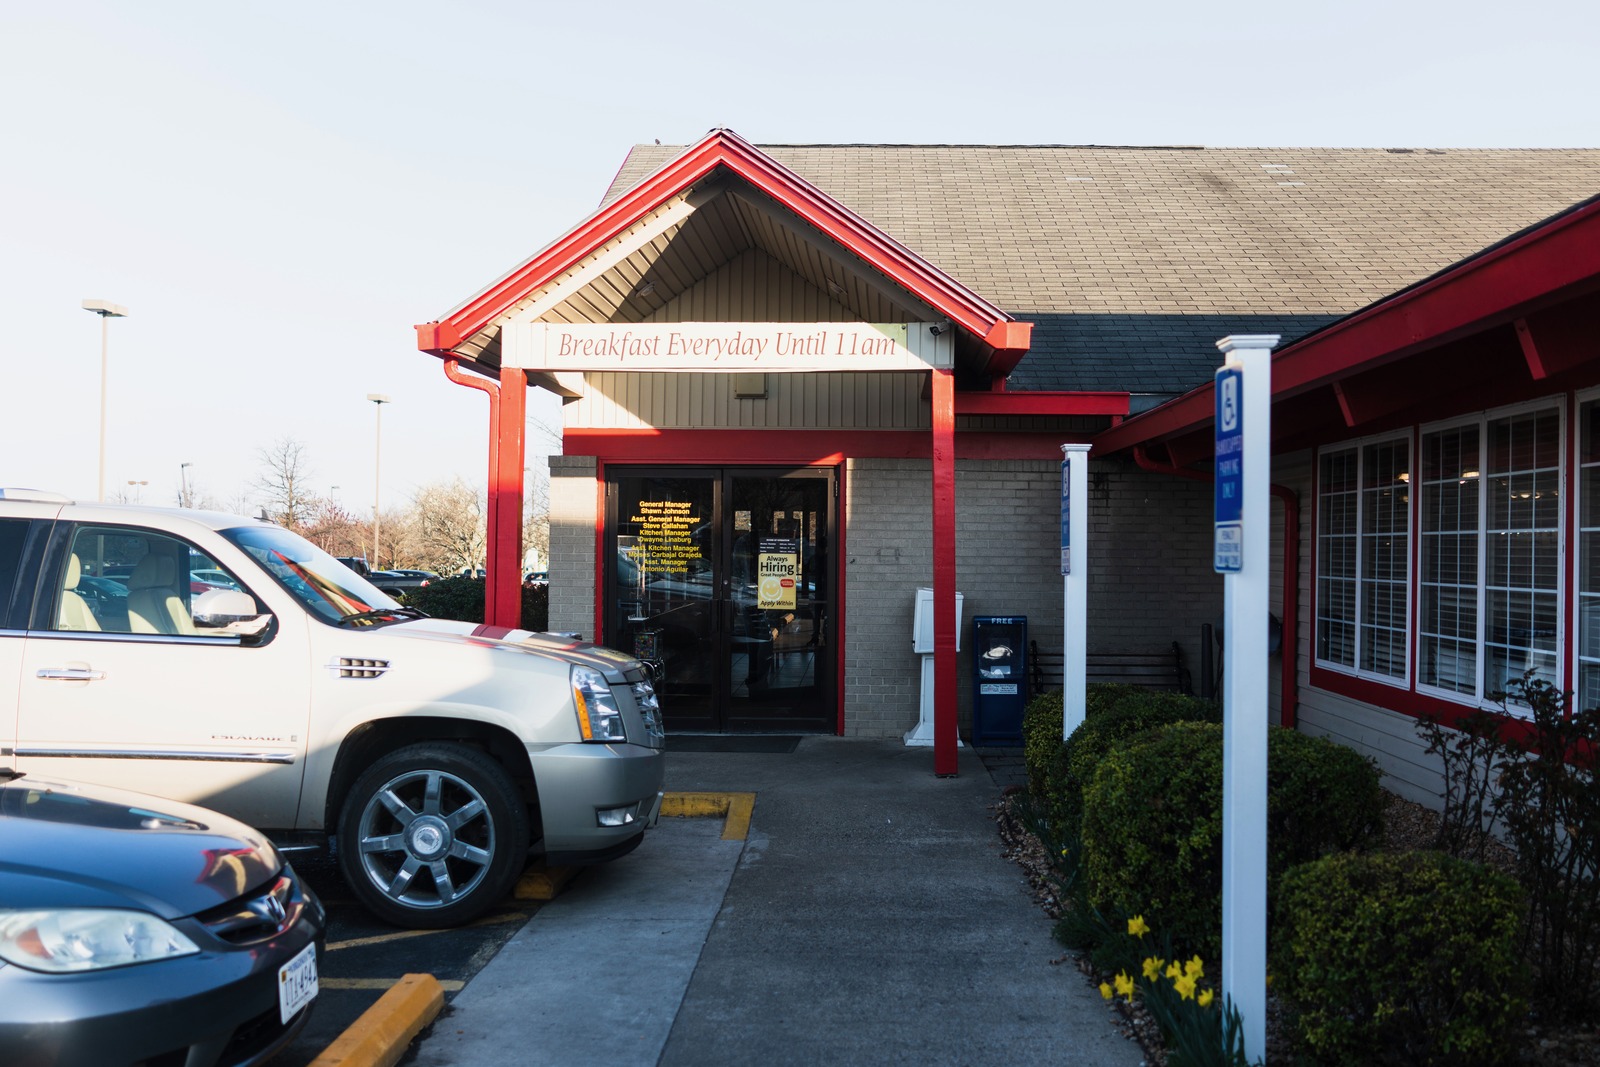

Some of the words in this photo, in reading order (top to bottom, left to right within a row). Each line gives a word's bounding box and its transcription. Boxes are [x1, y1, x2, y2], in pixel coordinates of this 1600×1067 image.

[558, 332, 660, 361] Breakfast
[667, 331, 768, 361] Everyday
[776, 332, 827, 356] Until
[835, 333, 895, 356] 11am
[665, 501, 692, 509] Manager
[674, 516, 701, 524] Manager
[678, 552, 702, 560] Grajeda
[760, 562, 794, 575] Hiring
